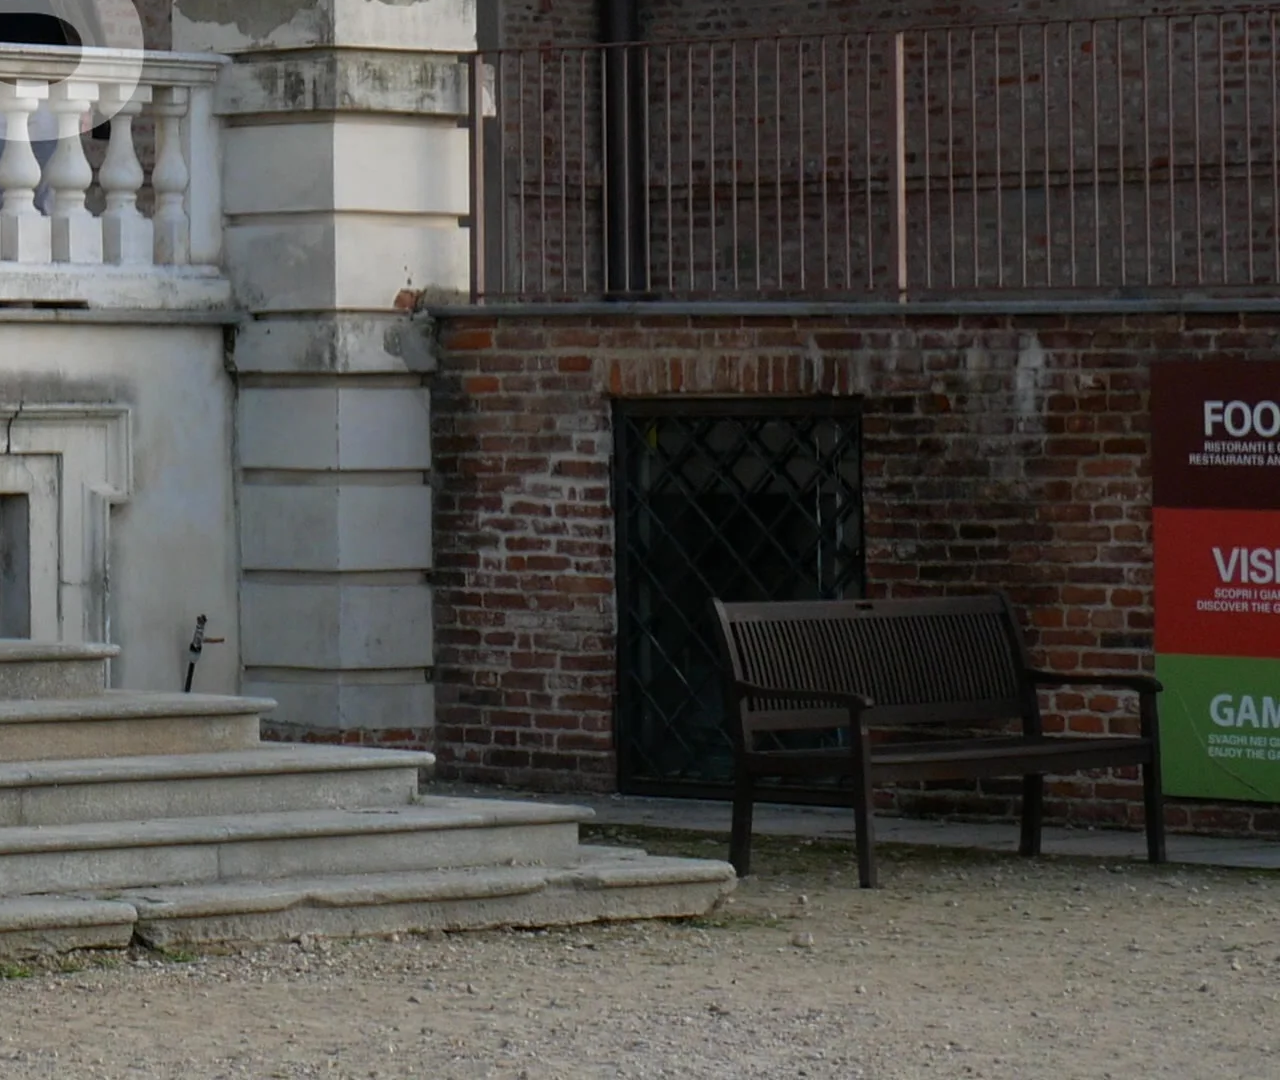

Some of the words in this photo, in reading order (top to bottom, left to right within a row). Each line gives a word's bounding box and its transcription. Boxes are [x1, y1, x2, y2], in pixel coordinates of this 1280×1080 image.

[1203, 399, 1280, 437] FOO
[1204, 440, 1265, 453] RISTORANTI
[1267, 442, 1275, 453] E
[1188, 453, 1265, 466] RESTAURANTS
[1214, 588, 1252, 600] SCOPRI
[1259, 590, 1280, 601] GIA
[1196, 600, 1249, 612] DISCOVER
[1251, 602, 1271, 613] THE
[1208, 733, 1248, 746] SVAGHI
[1249, 736, 1267, 746] NEI
[1207, 747, 1243, 759] ENJOY
[1246, 749, 1266, 760] THE
